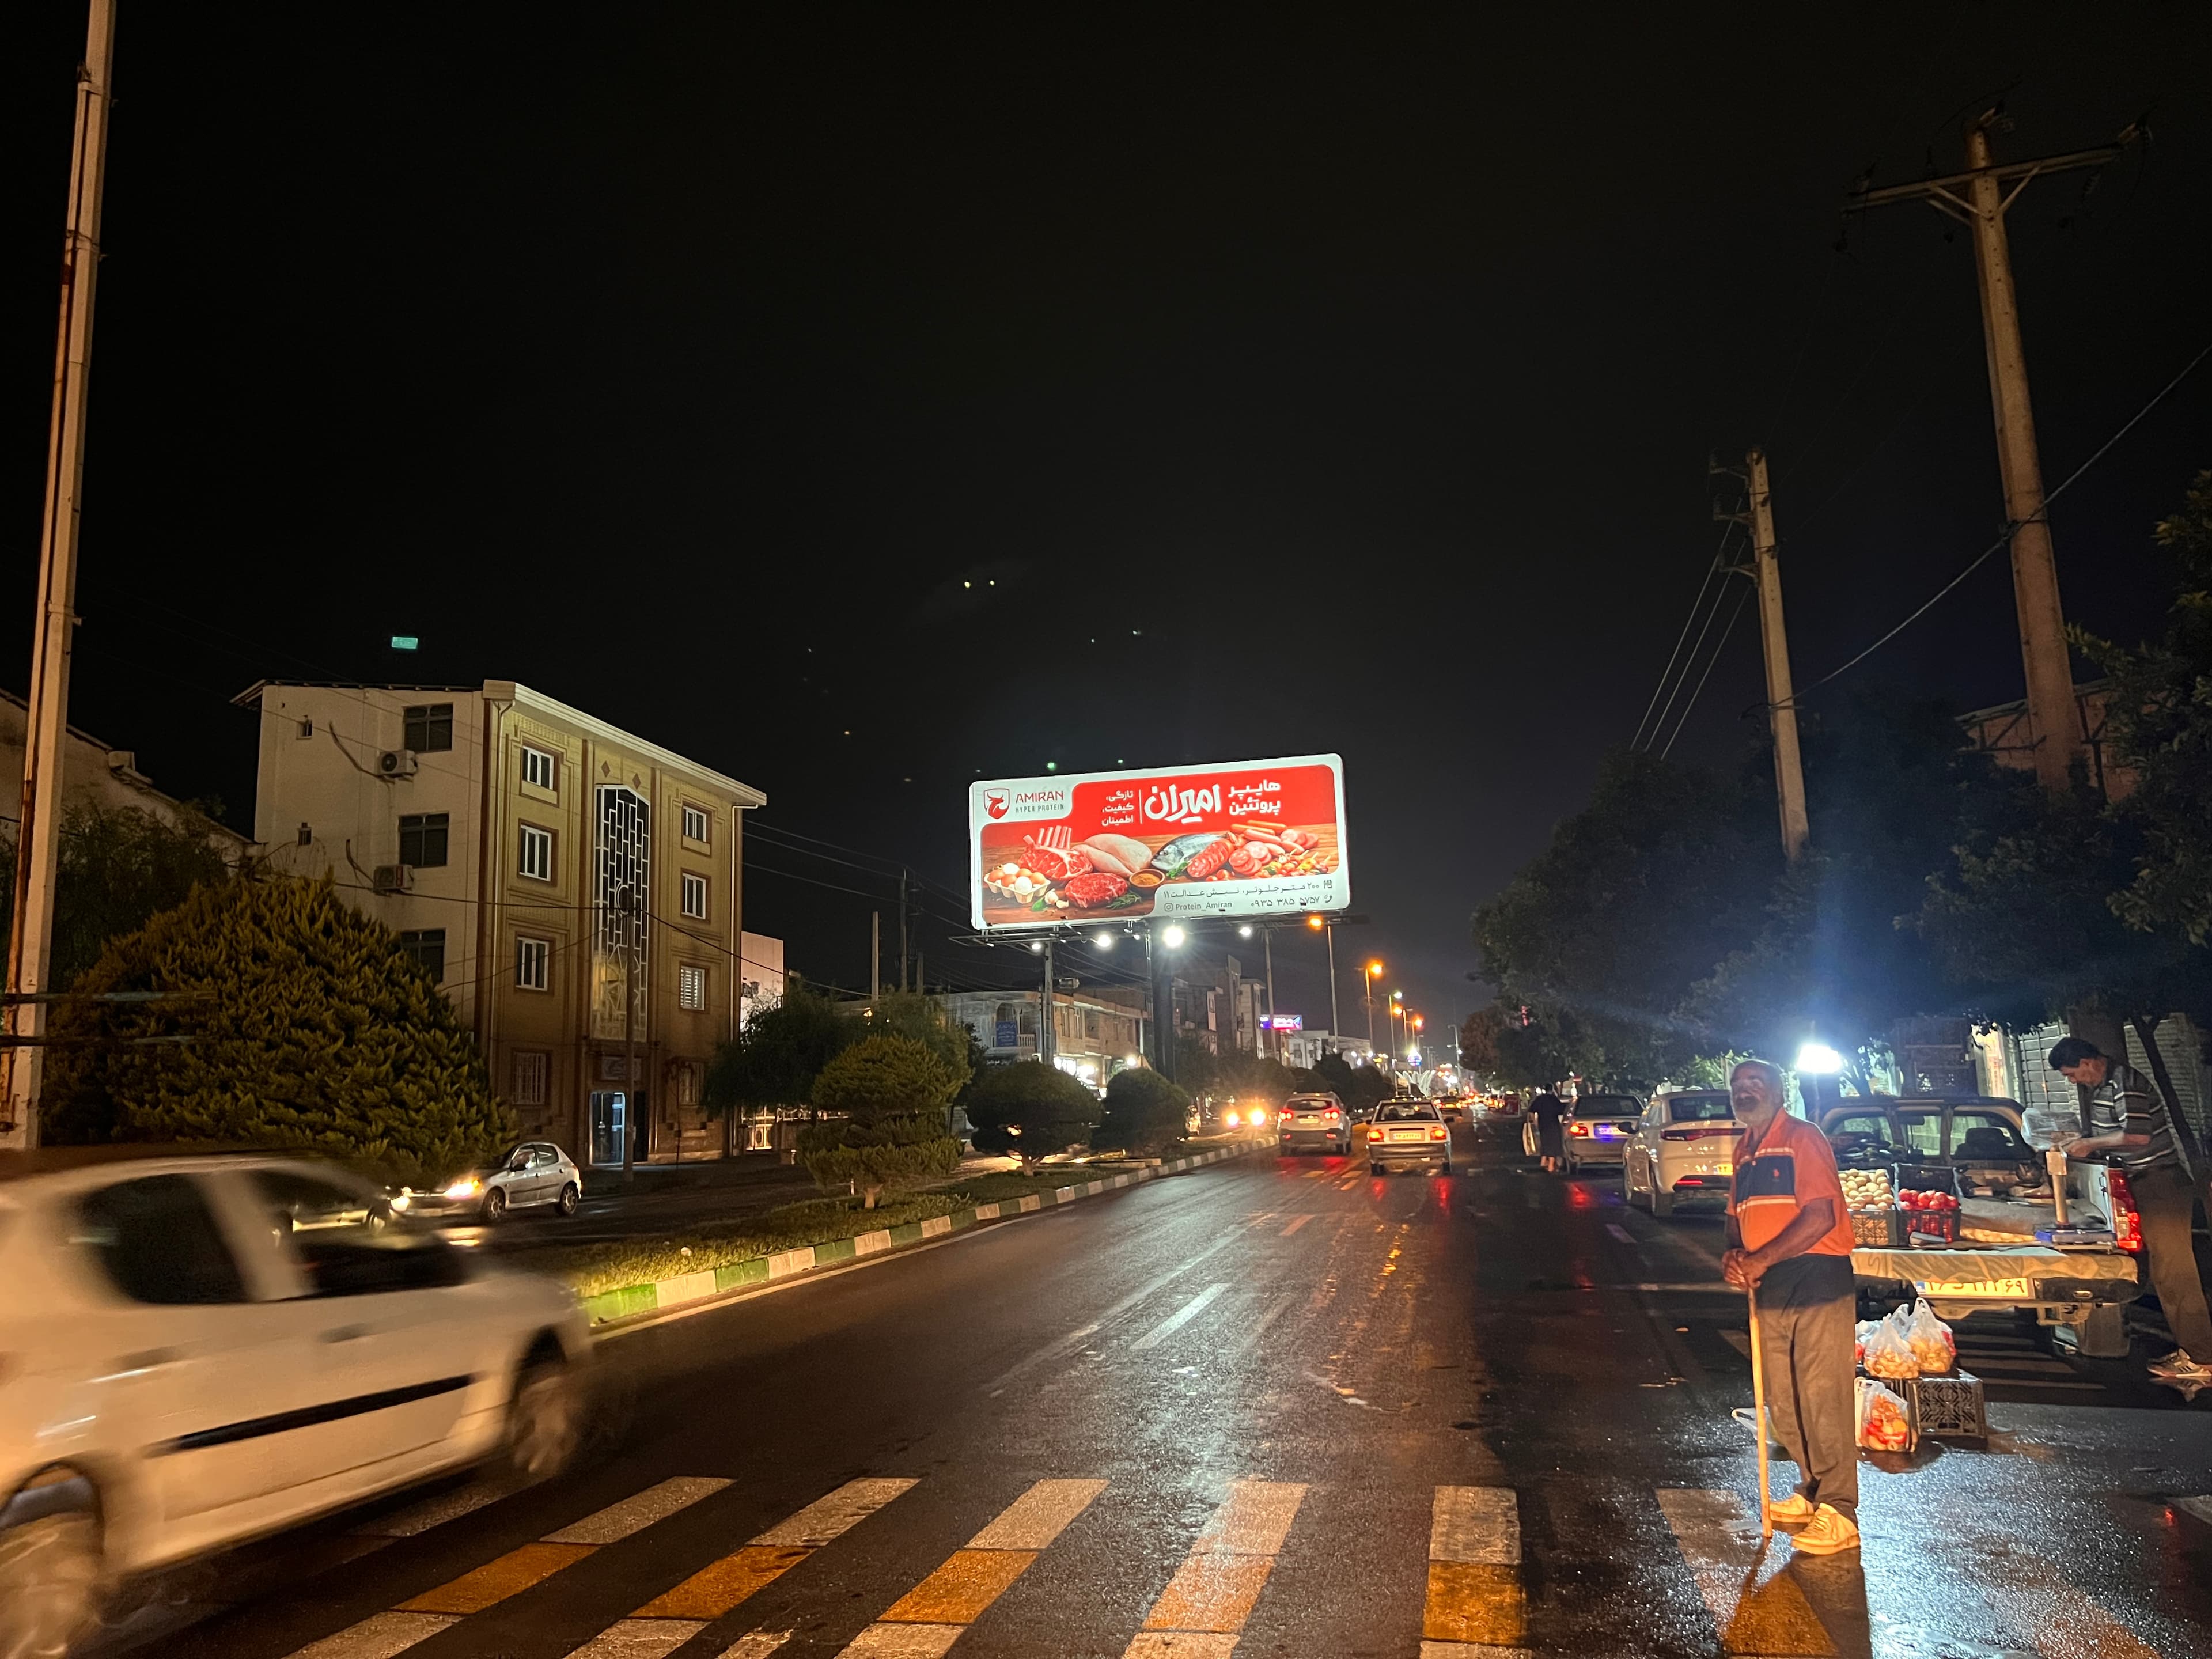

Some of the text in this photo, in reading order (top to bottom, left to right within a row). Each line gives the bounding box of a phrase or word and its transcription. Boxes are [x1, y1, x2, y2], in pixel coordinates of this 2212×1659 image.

[1228, 779, 1281, 800] هایپر
[1016, 790, 1064, 804] AMIRAN
[1144, 783, 1222, 824] امیران
[1015, 804, 1065, 813] HYPER PROTEIN
[1229, 797, 1281, 816] پروتئین
[1101, 816, 1134, 827] اطمینان
[1176, 902, 1233, 912] Protein_Amiran
